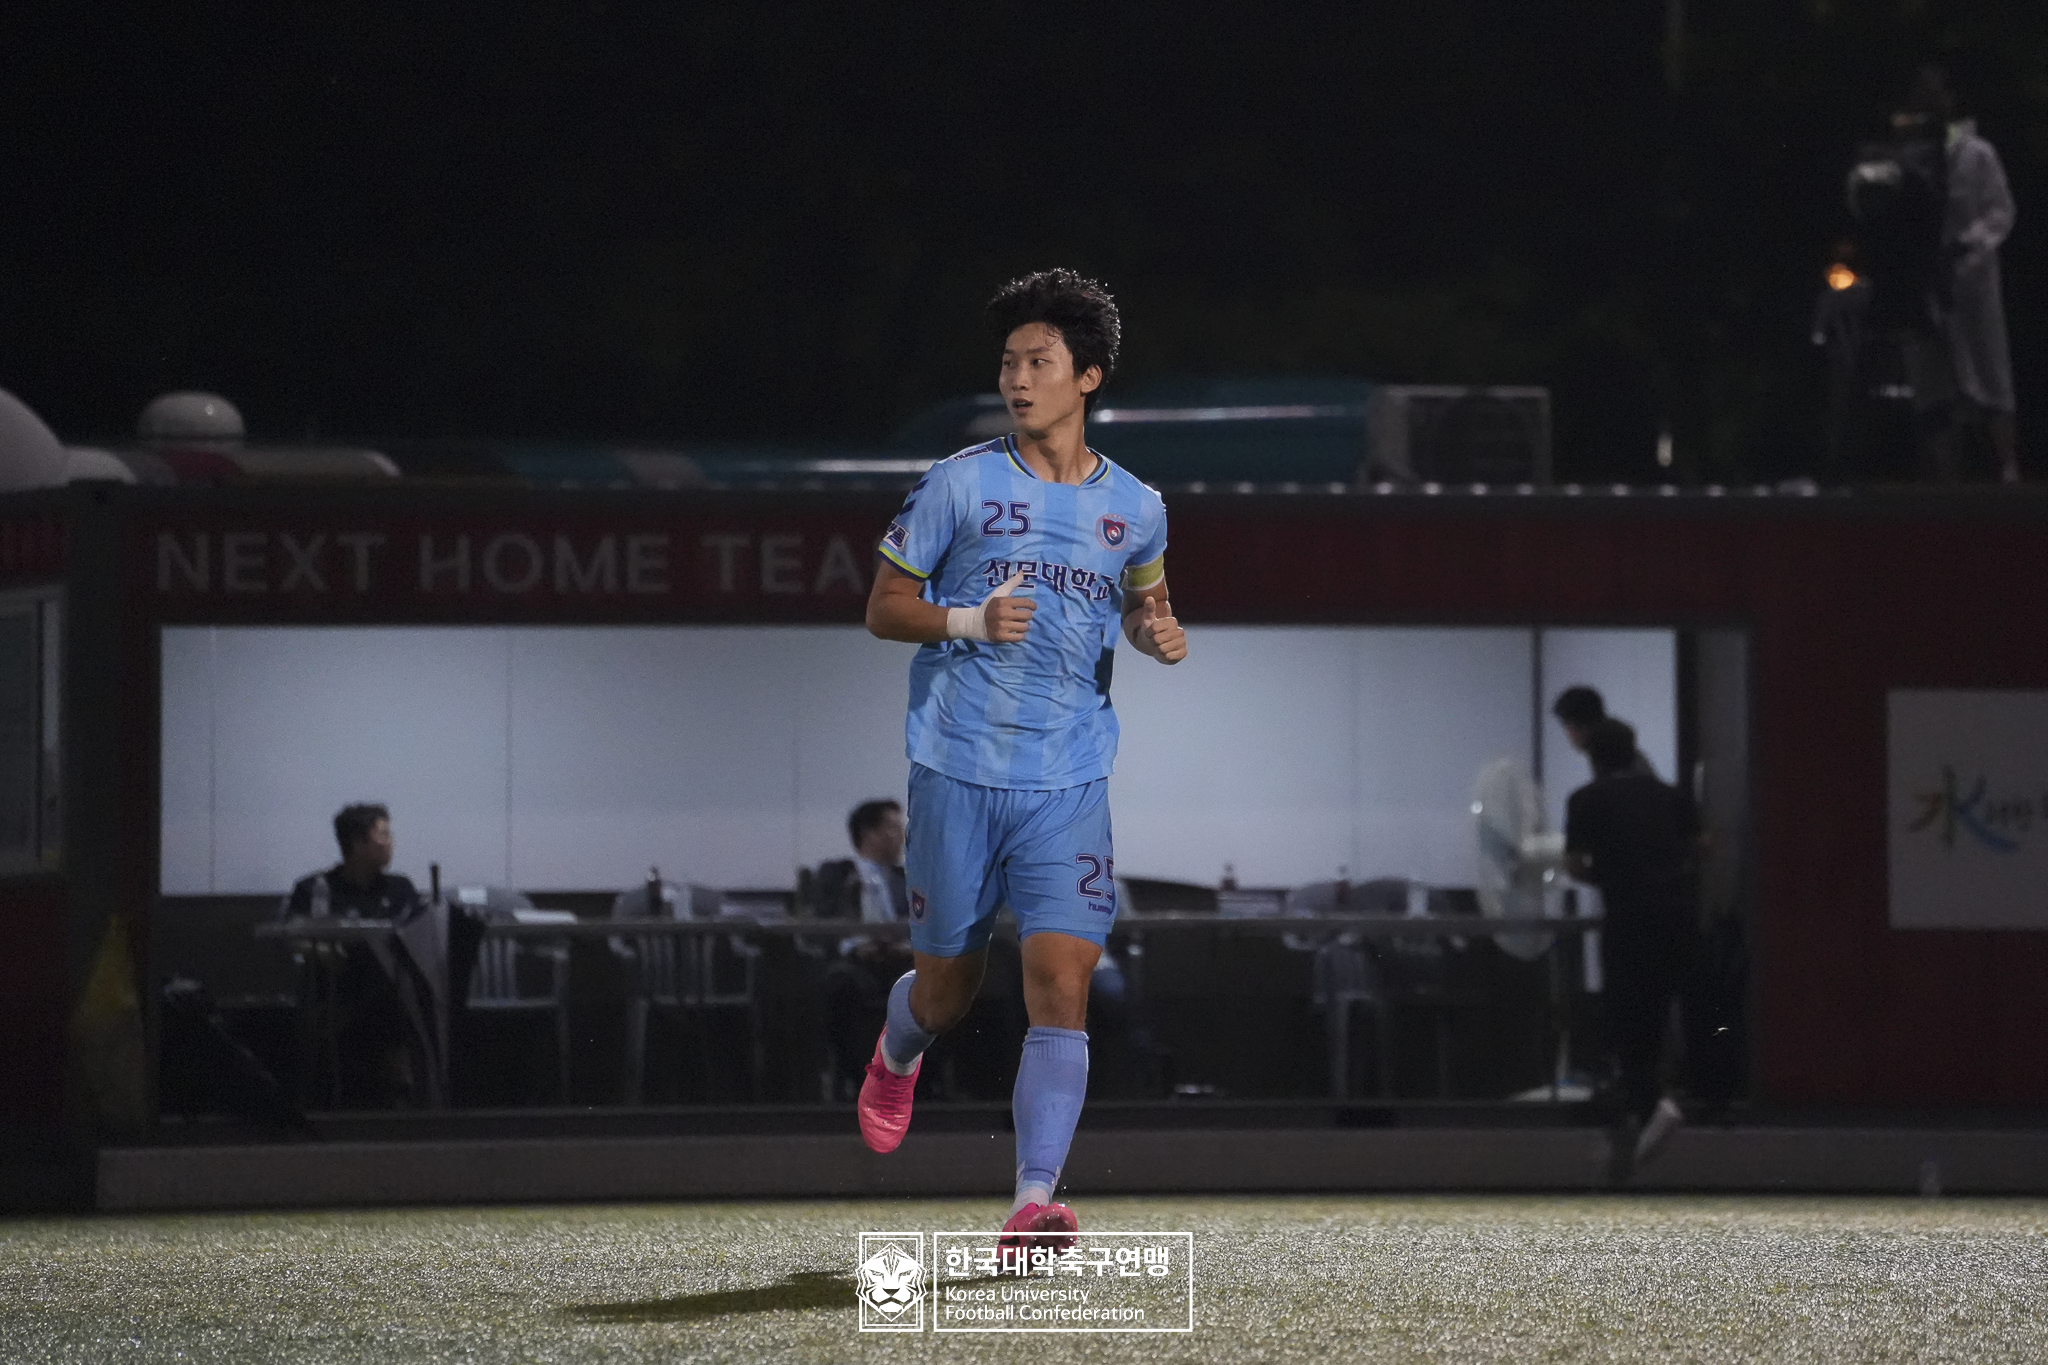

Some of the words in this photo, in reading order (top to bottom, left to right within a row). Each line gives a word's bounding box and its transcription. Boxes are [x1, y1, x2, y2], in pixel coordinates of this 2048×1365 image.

[981, 499, 1031, 537] 25
[156, 532, 386, 592] NEXT
[418, 532, 671, 595] HOME
[700, 532, 884, 595] TEA
